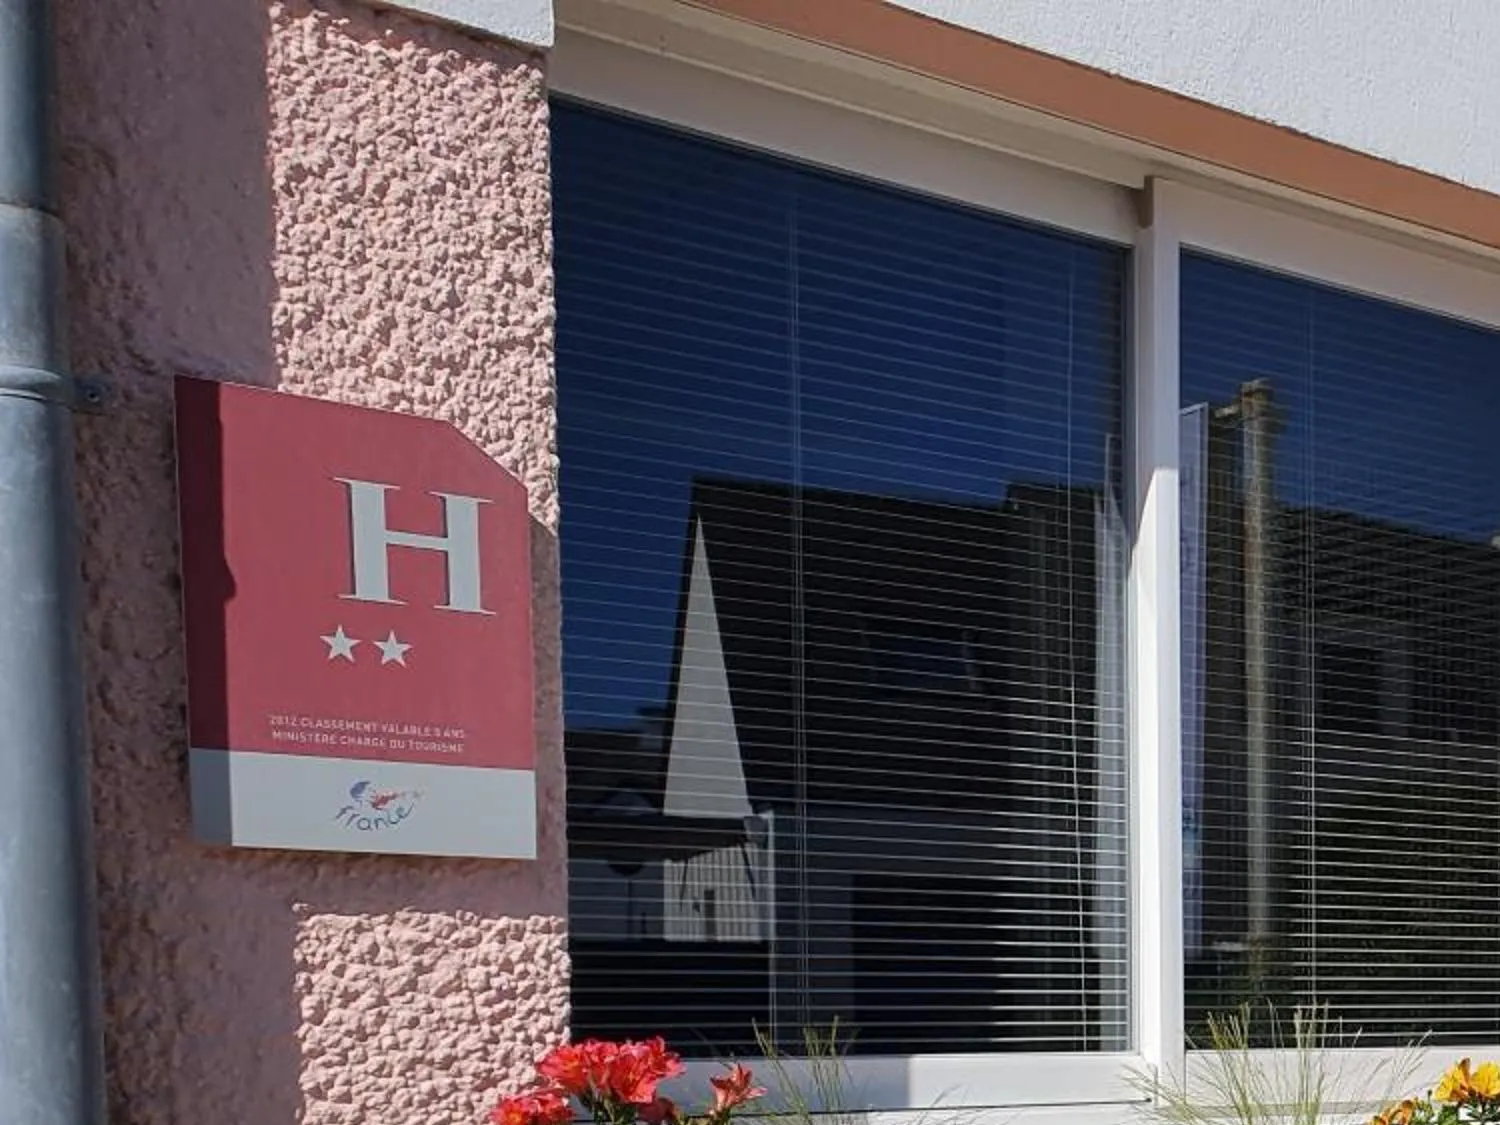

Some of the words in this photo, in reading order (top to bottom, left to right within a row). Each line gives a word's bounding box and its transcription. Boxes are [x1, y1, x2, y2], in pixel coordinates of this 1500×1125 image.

[333, 477, 496, 615] H
[299, 716, 377, 733] CLASSEMENT
[388, 738, 406, 750] DU
[408, 740, 464, 753] TOURISME
